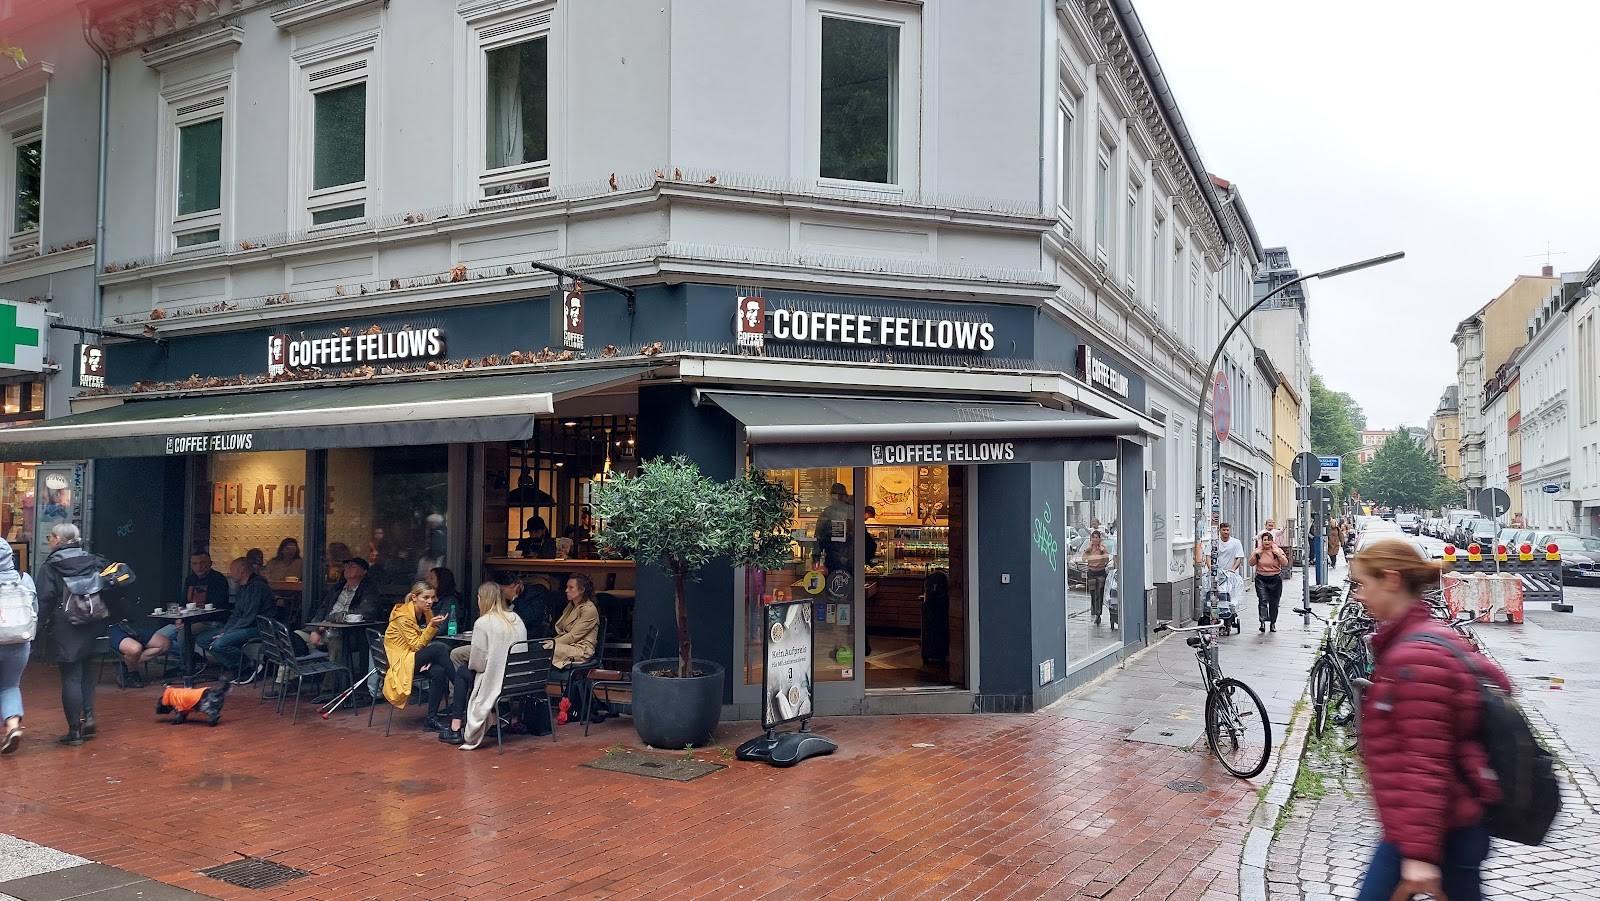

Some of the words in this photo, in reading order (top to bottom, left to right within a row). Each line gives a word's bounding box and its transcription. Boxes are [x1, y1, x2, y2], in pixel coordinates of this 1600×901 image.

[564, 331, 584, 344] COFFEE
[737, 331, 764, 341] COFFEE
[773, 309, 872, 344] COFFEE
[880, 316, 995, 351] FELLOWS
[289, 335, 352, 367] COFFEE
[356, 327, 440, 362] FELLOWS
[80, 374, 105, 384] COFFEE
[80, 381, 105, 389] FELLOWS
[174, 436, 209, 453] COFFEE
[209, 433, 253, 451] FELLOWS
[885, 444, 943, 463] COFFEE
[947, 442, 1015, 461] FELLOWS
[212, 482, 248, 514] EEL
[253, 484, 278, 514] AT
[283, 484, 336, 514] HOE
